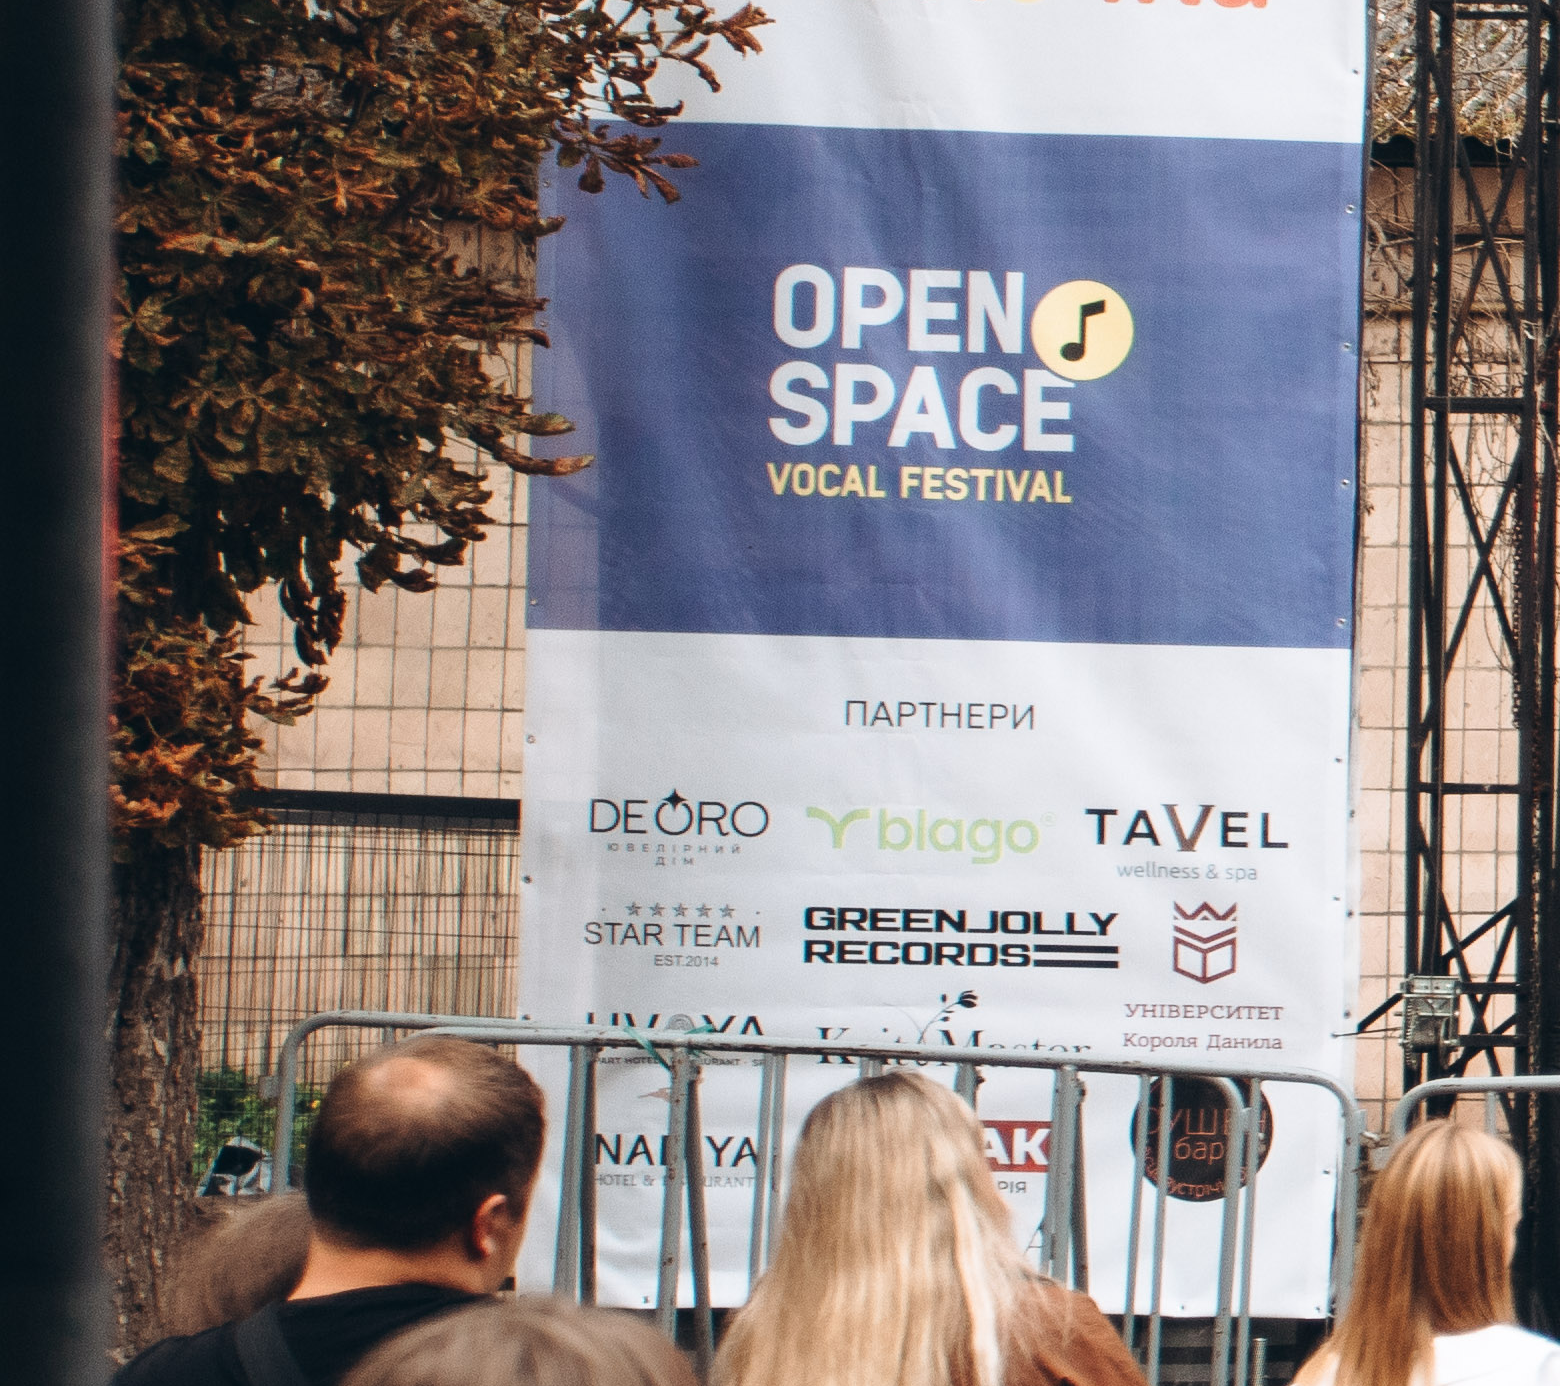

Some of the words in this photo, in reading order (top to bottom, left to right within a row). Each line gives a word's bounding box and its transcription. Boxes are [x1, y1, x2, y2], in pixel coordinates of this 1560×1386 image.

[772, 264, 1025, 355] OPEN
[768, 360, 1076, 453] SPACE
[767, 462, 886, 500] VOCAL
[900, 465, 1073, 504] FESTIVAL
[844, 699, 1036, 732] ПАРТНЕРИ
[877, 806, 1042, 865] blago
[1116, 861, 1198, 881] wellness
[1204, 862, 1219, 880] &
[1224, 865, 1258, 884] spa
[584, 921, 664, 946] STAR
[674, 923, 761, 948] TEAM
[804, 940, 1032, 968] RECORDS
[1124, 1003, 1284, 1021] УНІВЕРСИТЕТ
[1123, 1032, 1198, 1051] Короля
[1207, 1034, 1283, 1051] Данила
[595, 1133, 758, 1167] NAYA
[1174, 1135, 1225, 1165] бар
